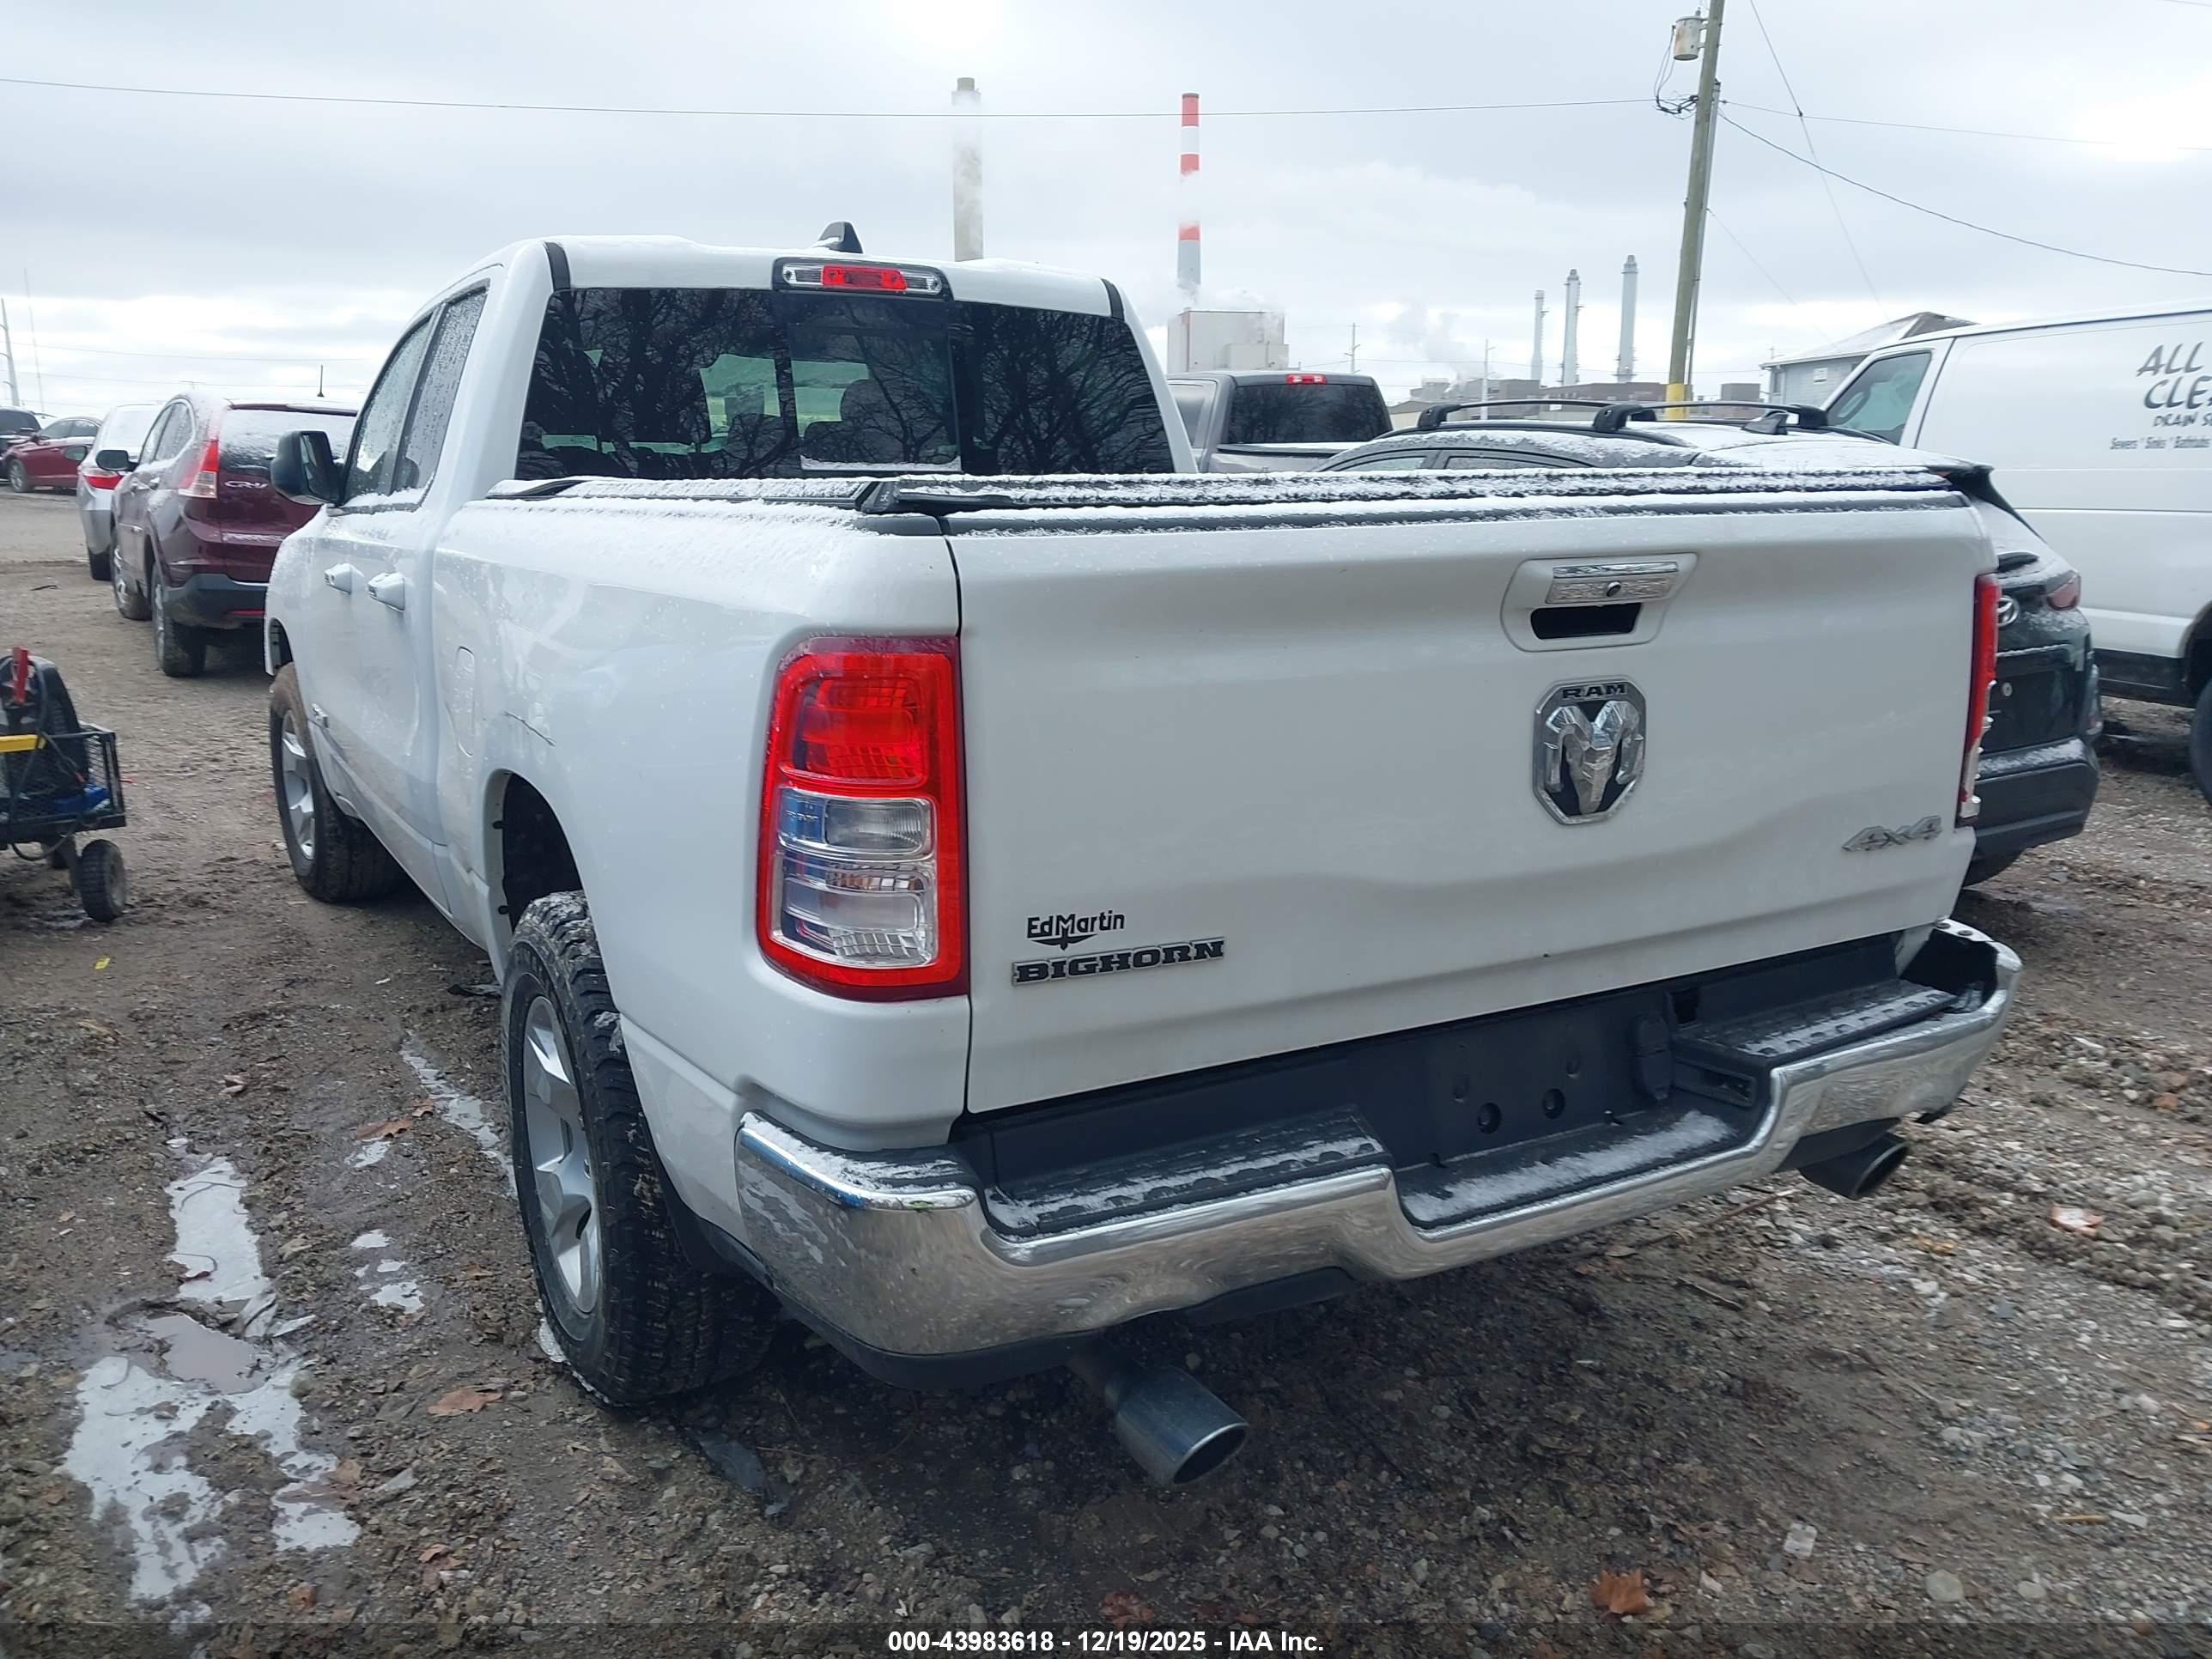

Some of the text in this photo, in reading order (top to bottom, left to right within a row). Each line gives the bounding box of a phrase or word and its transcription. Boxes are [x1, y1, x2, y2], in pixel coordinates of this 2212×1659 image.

[2136, 341, 2204, 377] ALL
[1563, 684, 1626, 700] RAM
[1013, 938, 1224, 984] BIGHORN
